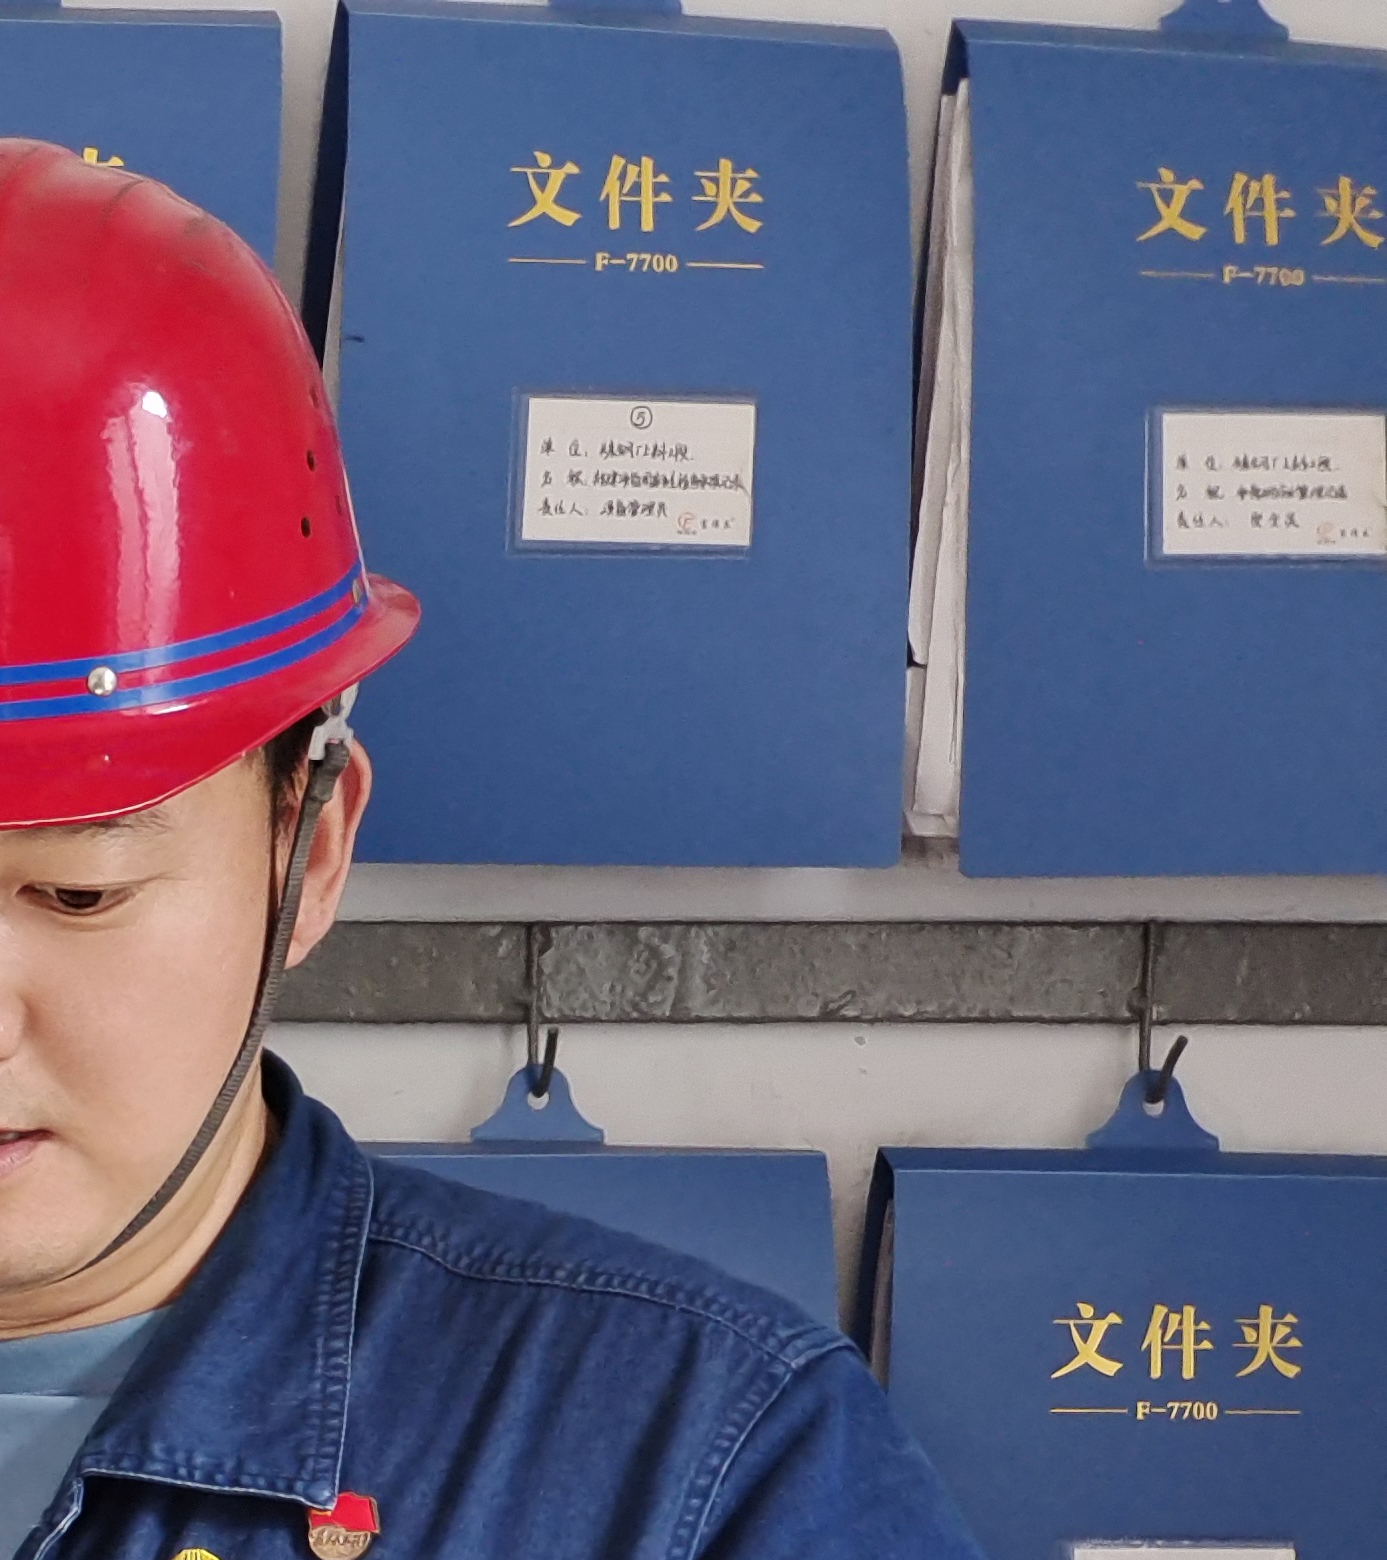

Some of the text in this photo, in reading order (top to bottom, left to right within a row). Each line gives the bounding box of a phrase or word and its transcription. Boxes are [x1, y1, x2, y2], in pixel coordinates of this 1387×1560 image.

[508, 151, 764, 234] 文件夹
[1135, 166, 1385, 250] 文件夹
[594, 252, 679, 273] F-7700
[1221, 264, 1306, 287] F-7700
[1050, 1302, 1304, 1380] 文件夹
[1134, 1401, 1220, 1422] F-7700
